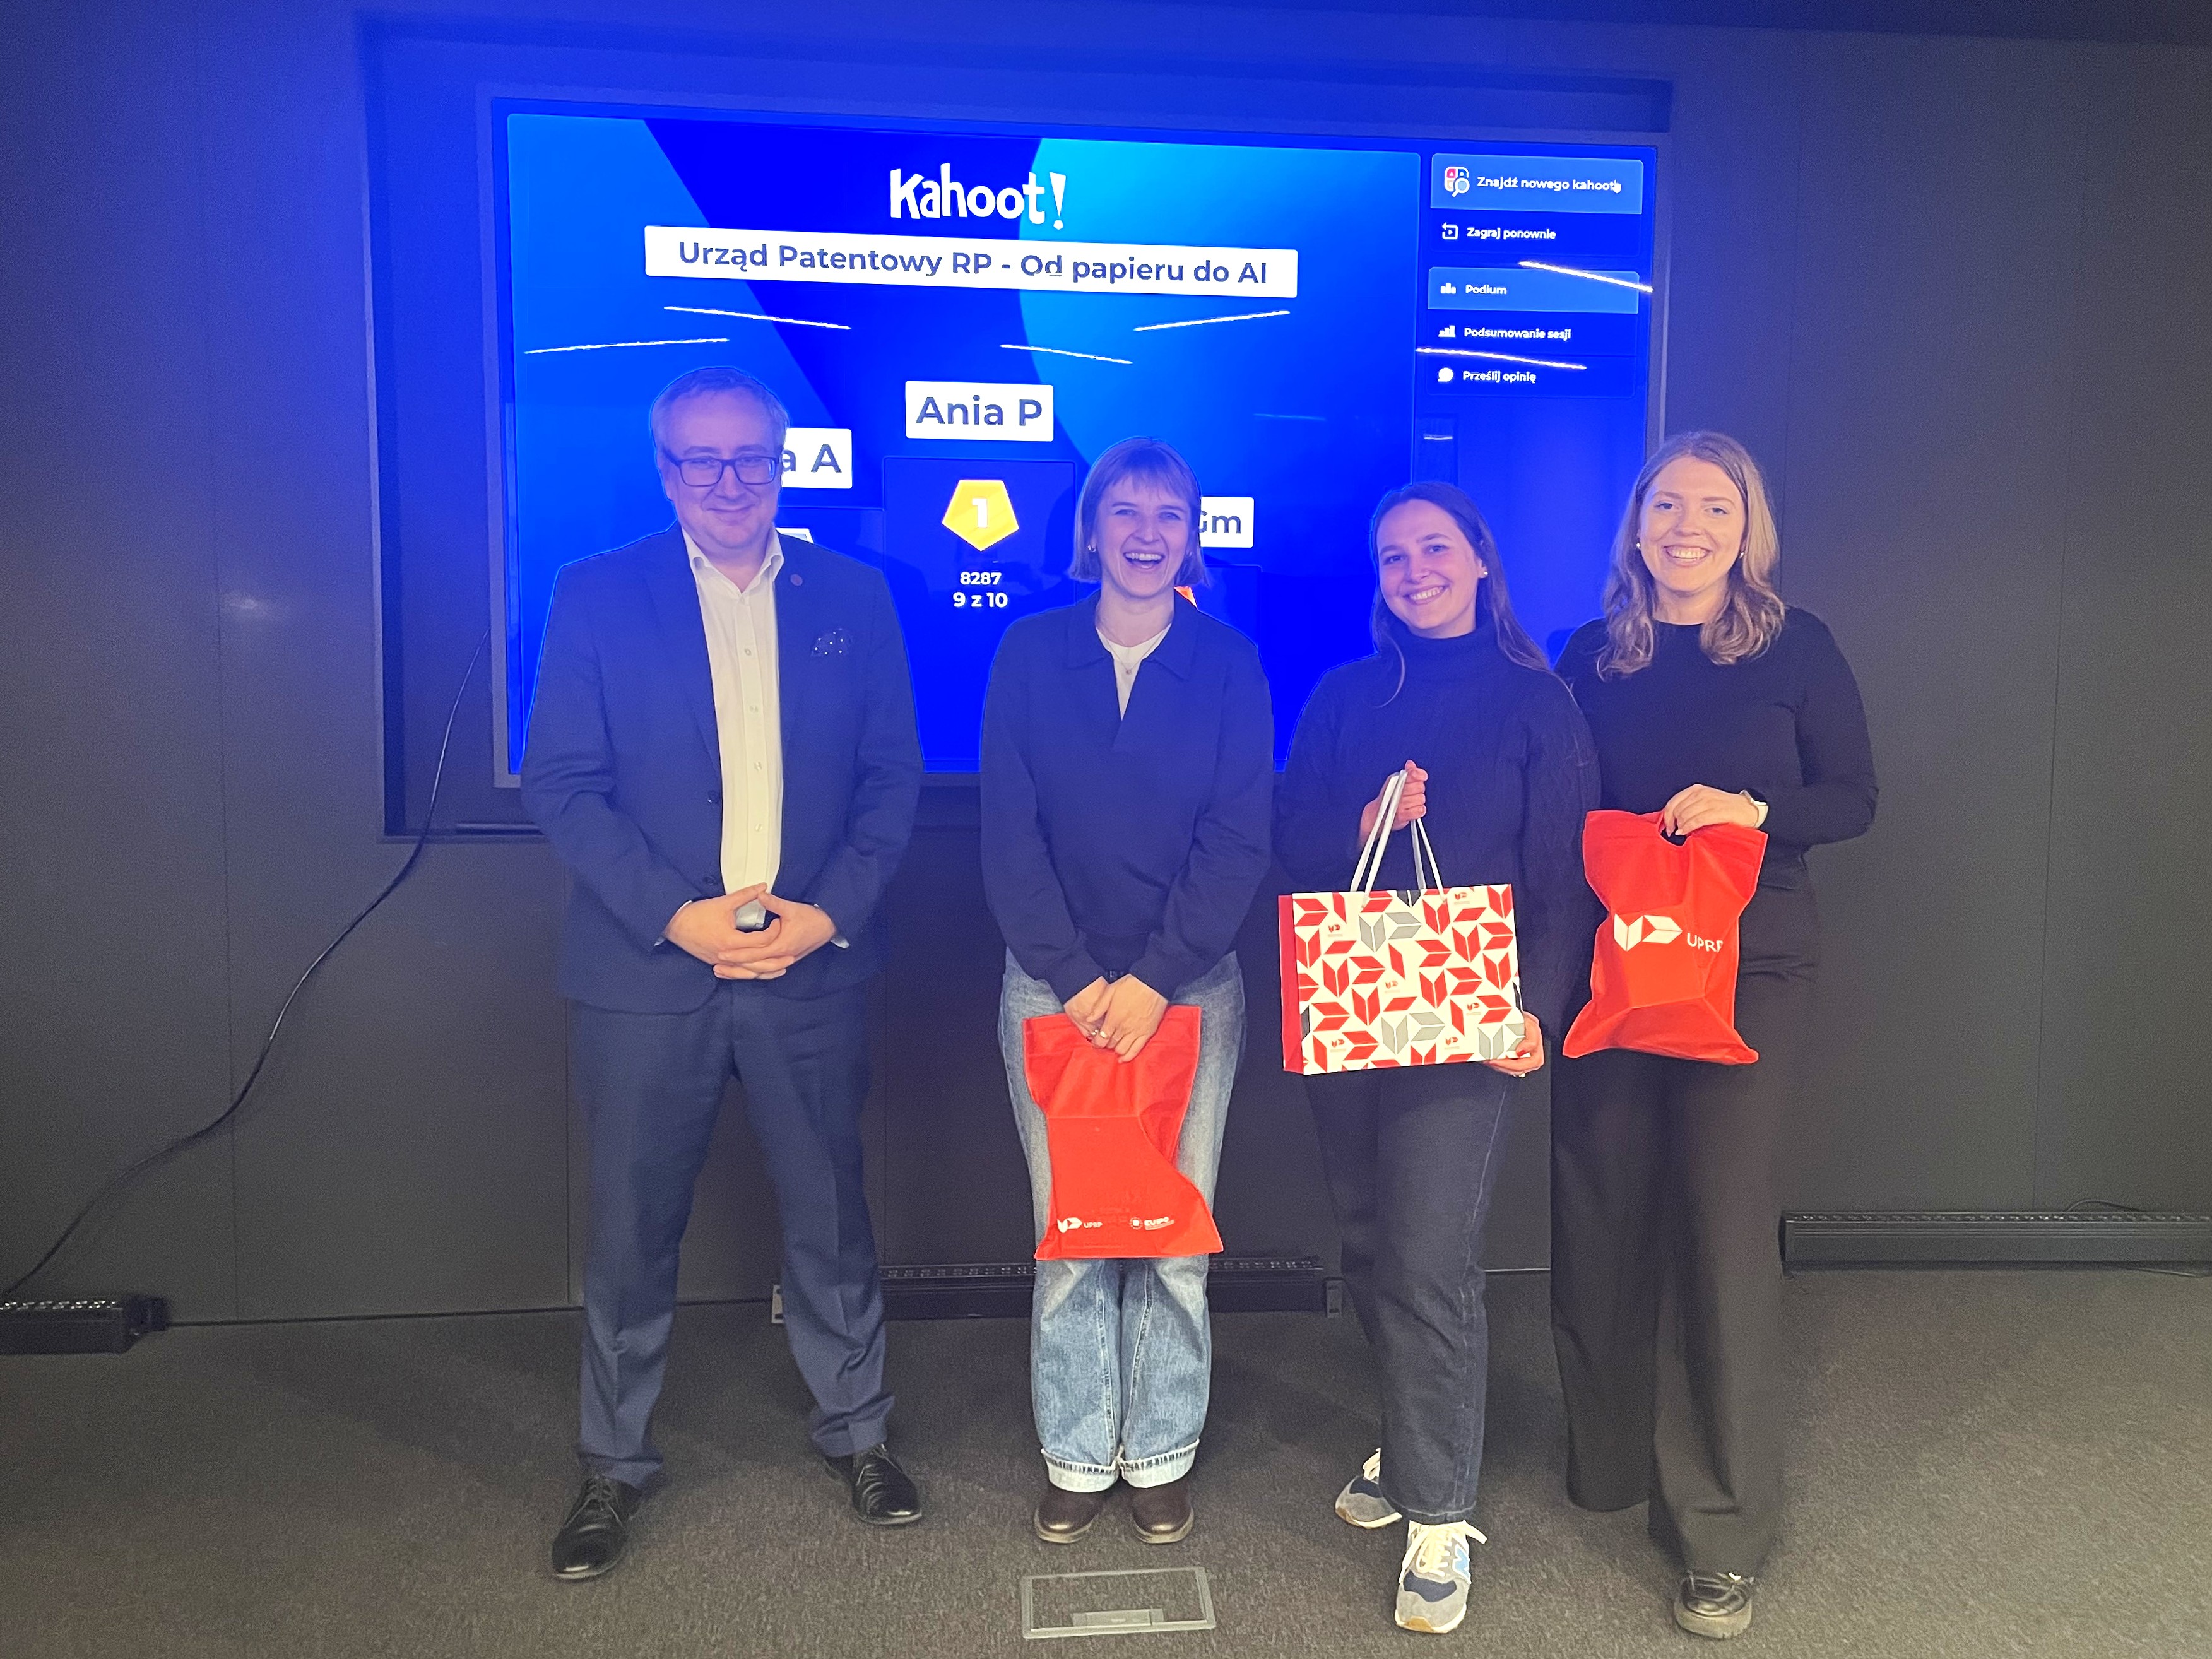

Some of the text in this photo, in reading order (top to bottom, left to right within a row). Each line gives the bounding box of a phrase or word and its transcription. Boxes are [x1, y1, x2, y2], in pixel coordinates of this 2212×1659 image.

[1477, 177, 1518, 189] Znajdź
[1521, 180, 1570, 191] nowego
[890, 163, 1066, 230] Kahoot!
[1467, 228, 1556, 239] Zagraj ponownie
[680, 242, 767, 272] Urząd
[779, 245, 942, 276] Patentowy
[953, 252, 991, 274] RP
[1021, 255, 1062, 276] Od
[1073, 257, 1183, 284] papieru
[1194, 260, 1229, 282] do
[1238, 263, 1266, 283] AI
[1466, 285, 1506, 294] Podium
[1465, 328, 1571, 341] Podsumowanie sesji
[1464, 371, 1536, 384] Prześlij opinię
[916, 395, 1042, 426] Ania P
[811, 444, 842, 473] A
[973, 498, 988, 528] 1
[961, 572, 1002, 585] 8287
[953, 592, 1008, 608] 9 z 10
